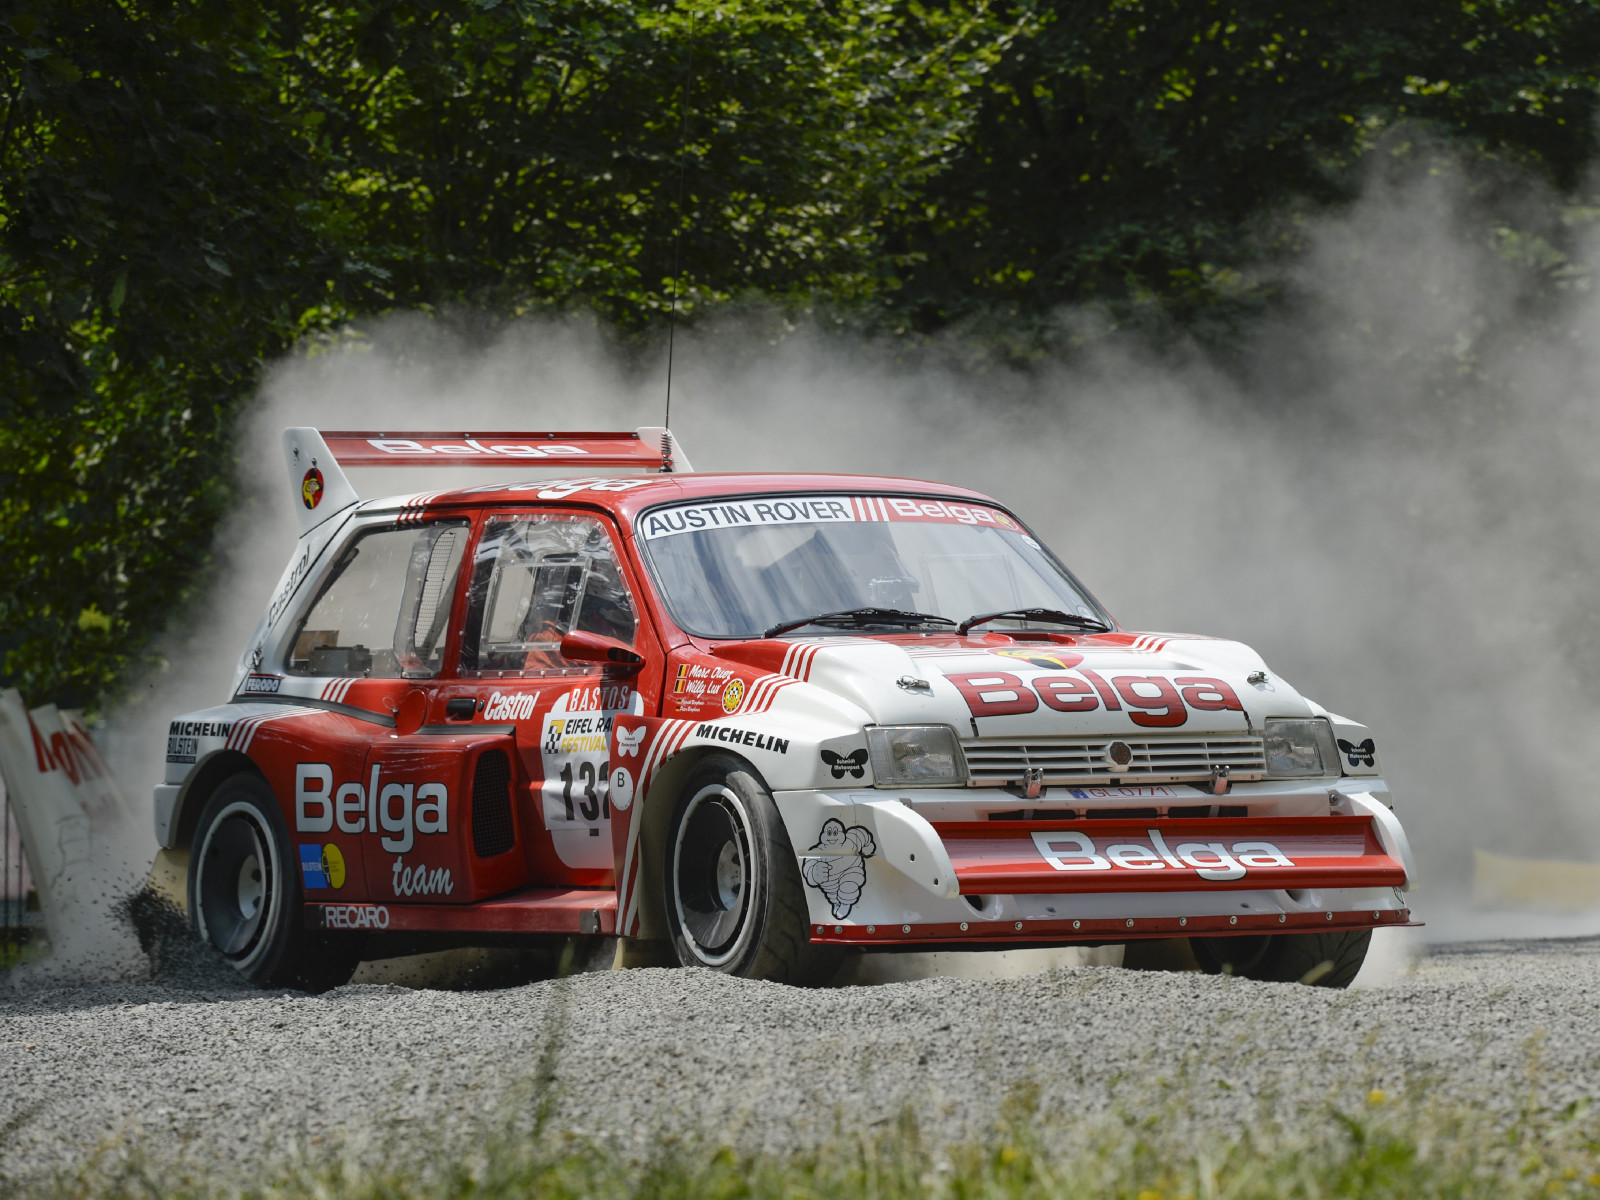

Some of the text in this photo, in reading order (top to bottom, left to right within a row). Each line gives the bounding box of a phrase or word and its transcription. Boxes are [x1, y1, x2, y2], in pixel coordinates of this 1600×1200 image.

[366, 439, 590, 457] Belga
[649, 501, 851, 536] AUSTIN ROVER
[890, 499, 994, 525] Belga
[267, 543, 311, 628] Castrol
[689, 664, 711, 678] Marc
[246, 679, 279, 691] FERODO
[686, 680, 706, 699] Willy
[484, 691, 541, 720] Castrol
[569, 685, 630, 712] BASTOS
[942, 669, 1245, 728] Belga
[169, 721, 231, 737] MICHELIN
[565, 717, 614, 734] EIFEL RA
[167, 738, 200, 755] BILSTEIN
[561, 735, 607, 753] FESTIVAL
[695, 723, 791, 755] MICHELIN
[617, 771, 625, 788] B
[295, 762, 449, 854] Belga
[1029, 828, 1297, 882] Belga
[392, 855, 454, 897] team
[325, 905, 390, 930] RECARO
